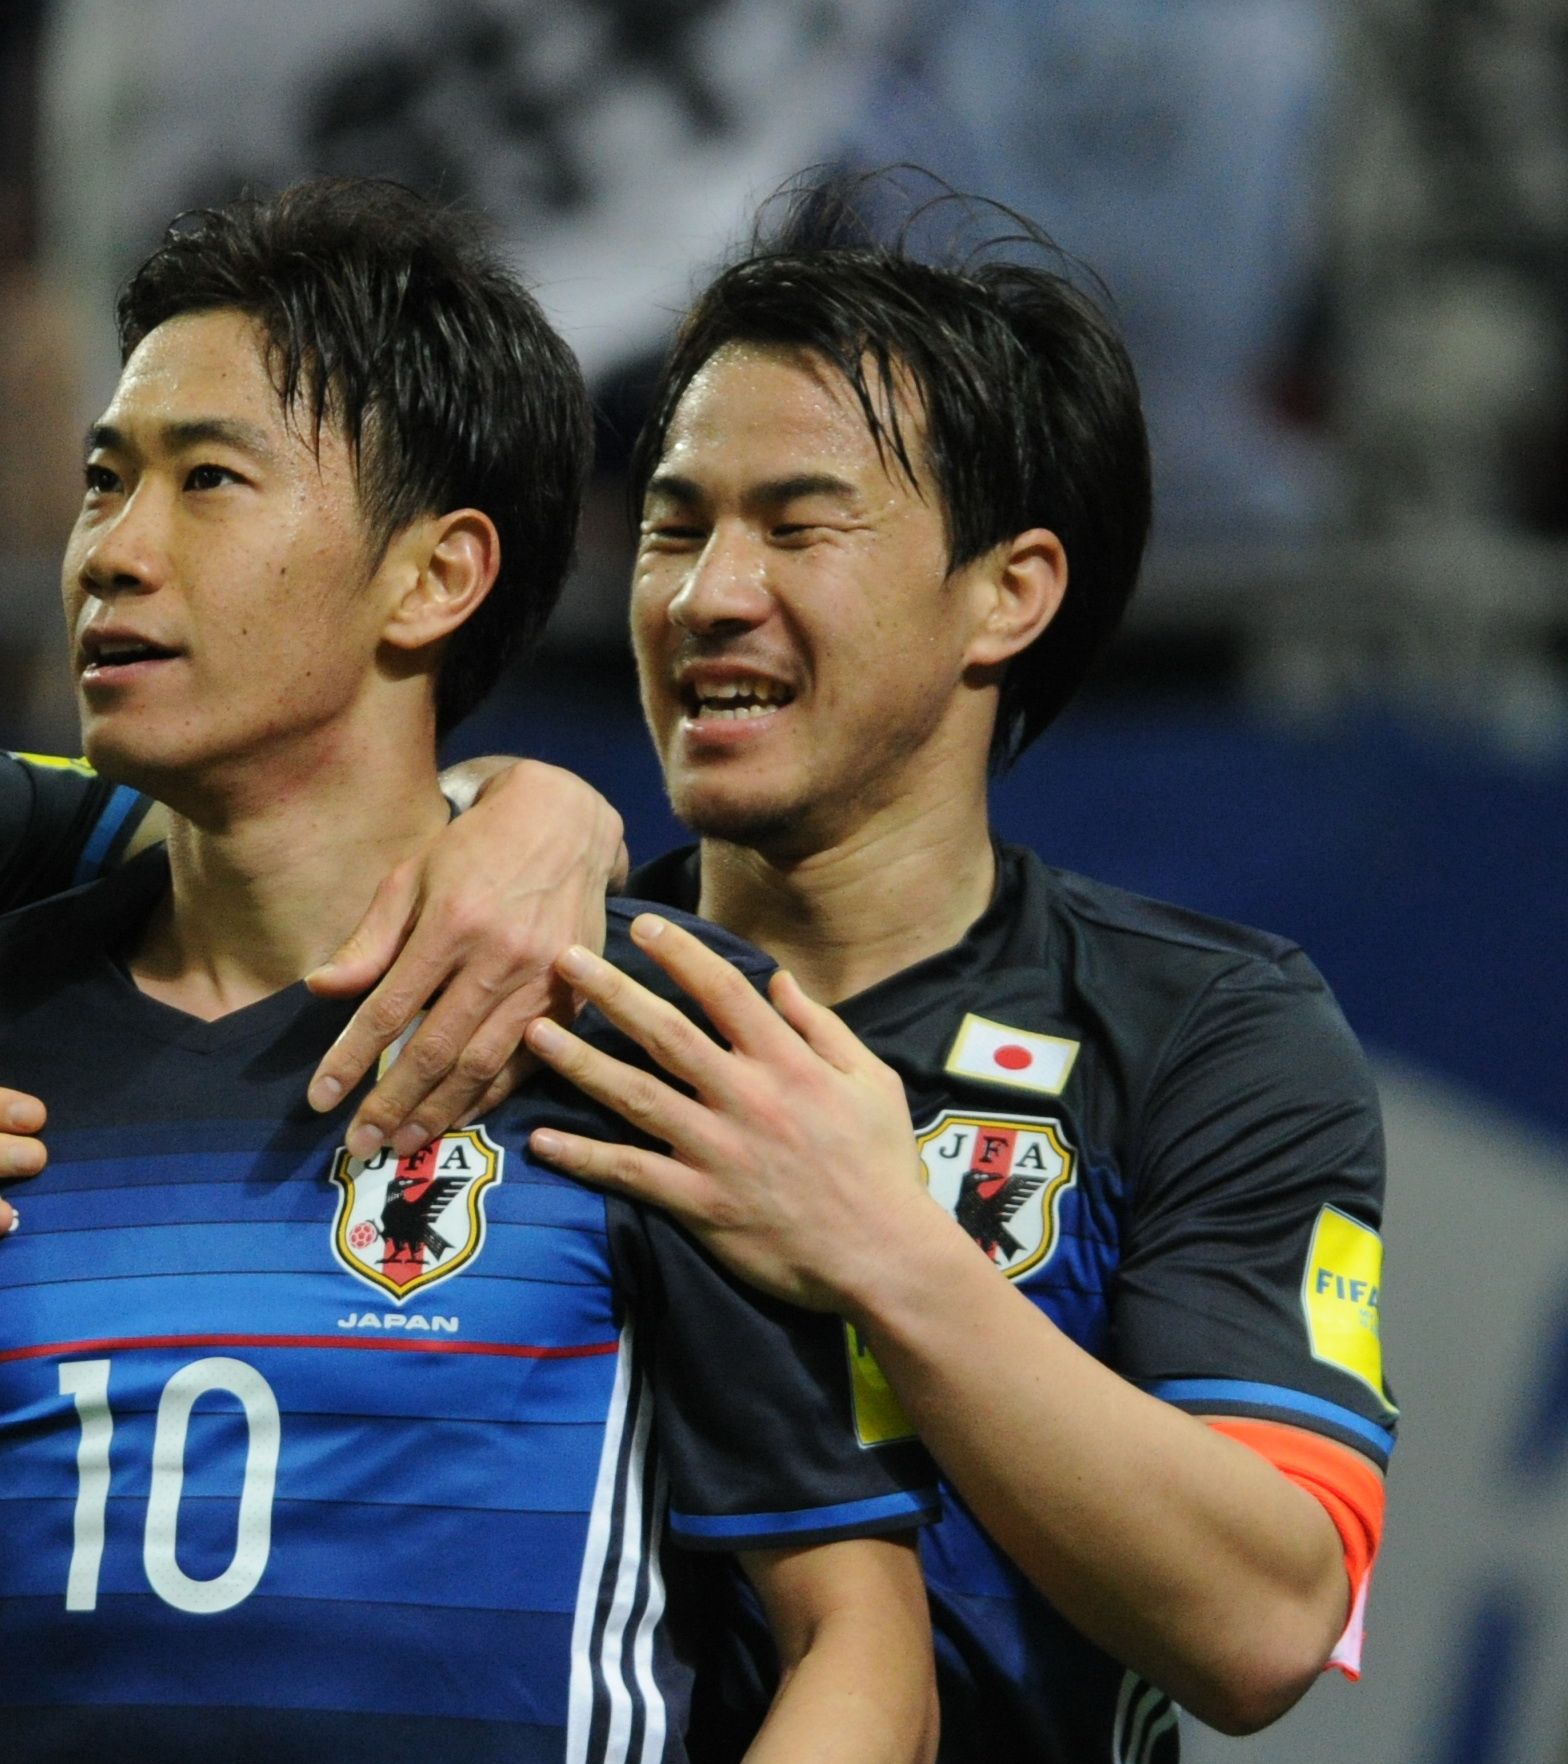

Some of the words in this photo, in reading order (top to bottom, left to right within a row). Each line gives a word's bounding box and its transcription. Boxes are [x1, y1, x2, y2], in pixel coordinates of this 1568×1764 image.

[939, 1132, 1048, 1171] JFA
[337, 1312, 459, 1333] JAPAN
[58, 1356, 281, 1614] 10
